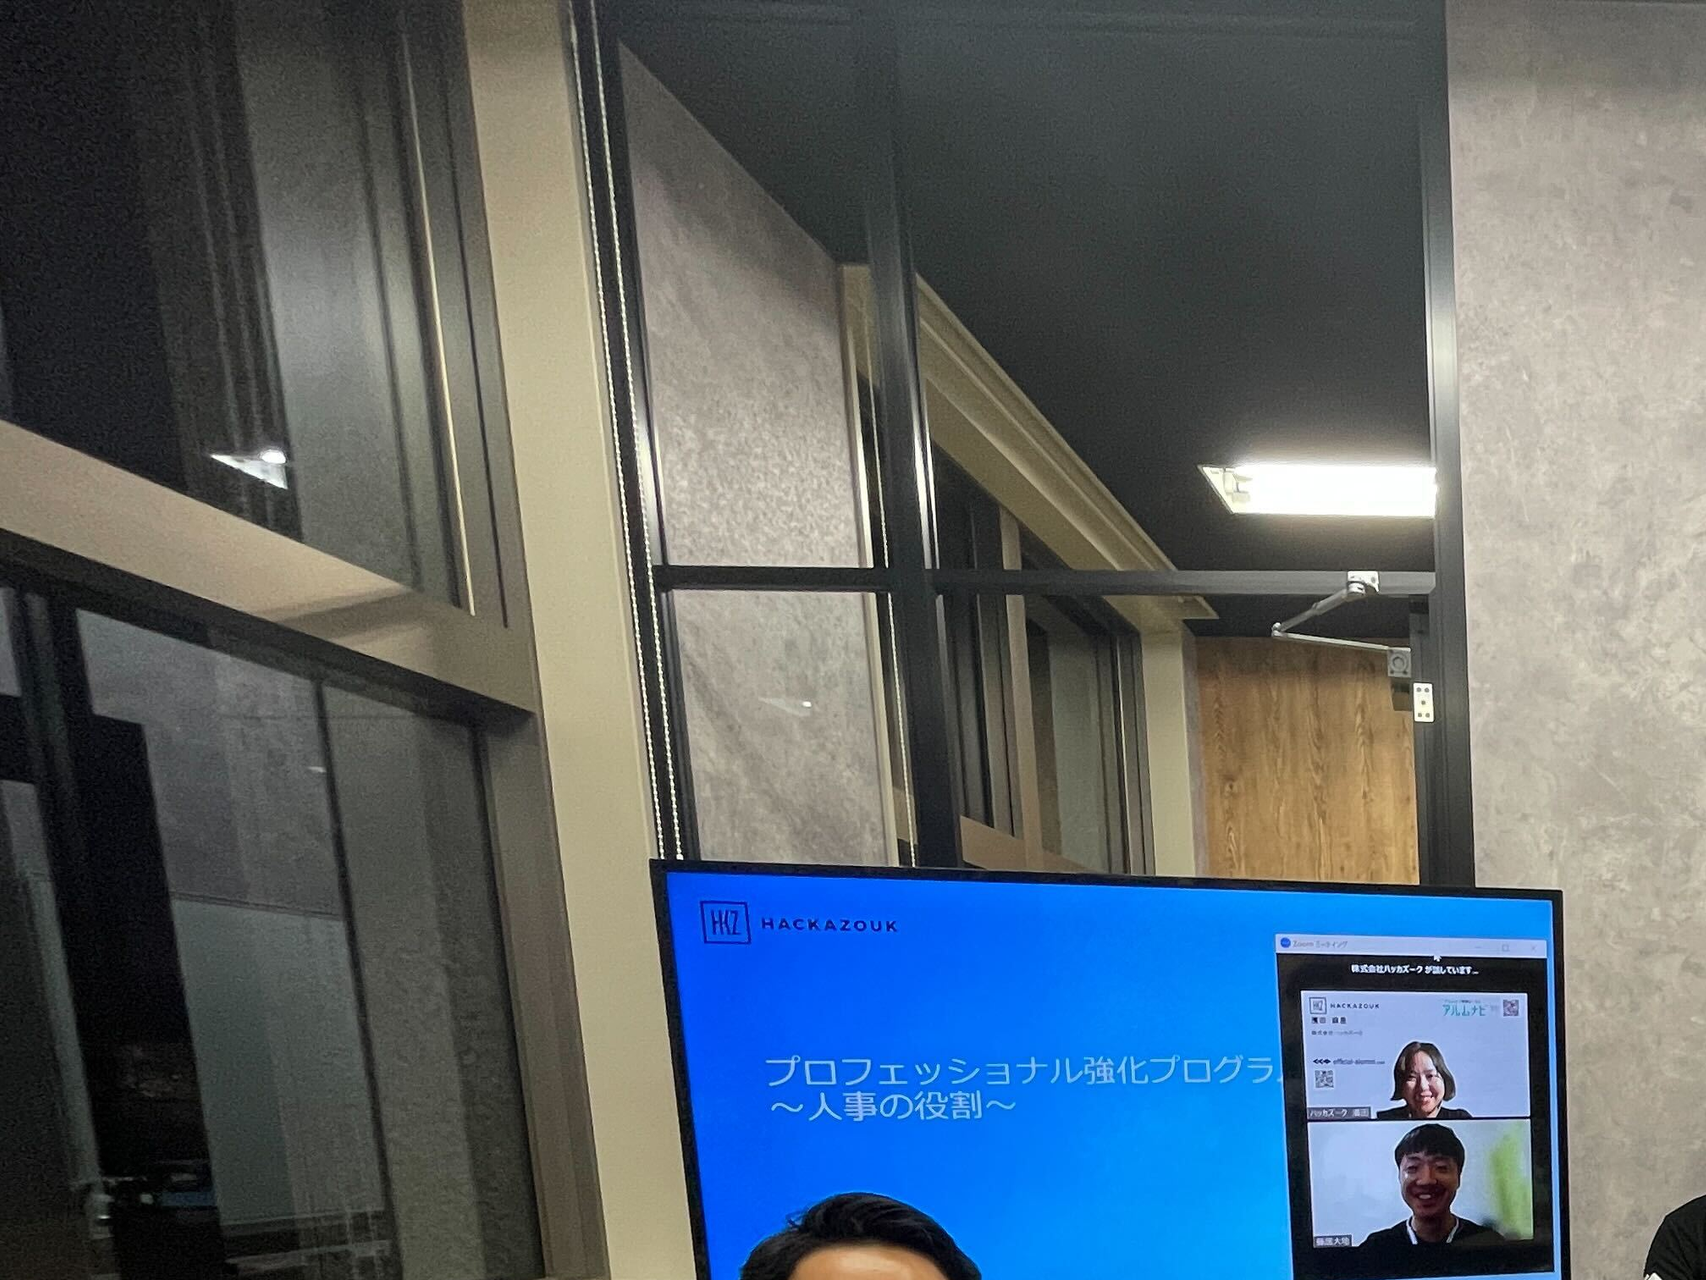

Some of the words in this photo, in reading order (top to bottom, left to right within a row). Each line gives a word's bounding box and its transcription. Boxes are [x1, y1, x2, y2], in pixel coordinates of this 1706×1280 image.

[761, 907, 898, 933] HACKAZOUK
[765, 1055, 1283, 1087] プロフェッショナル強化プログラ
